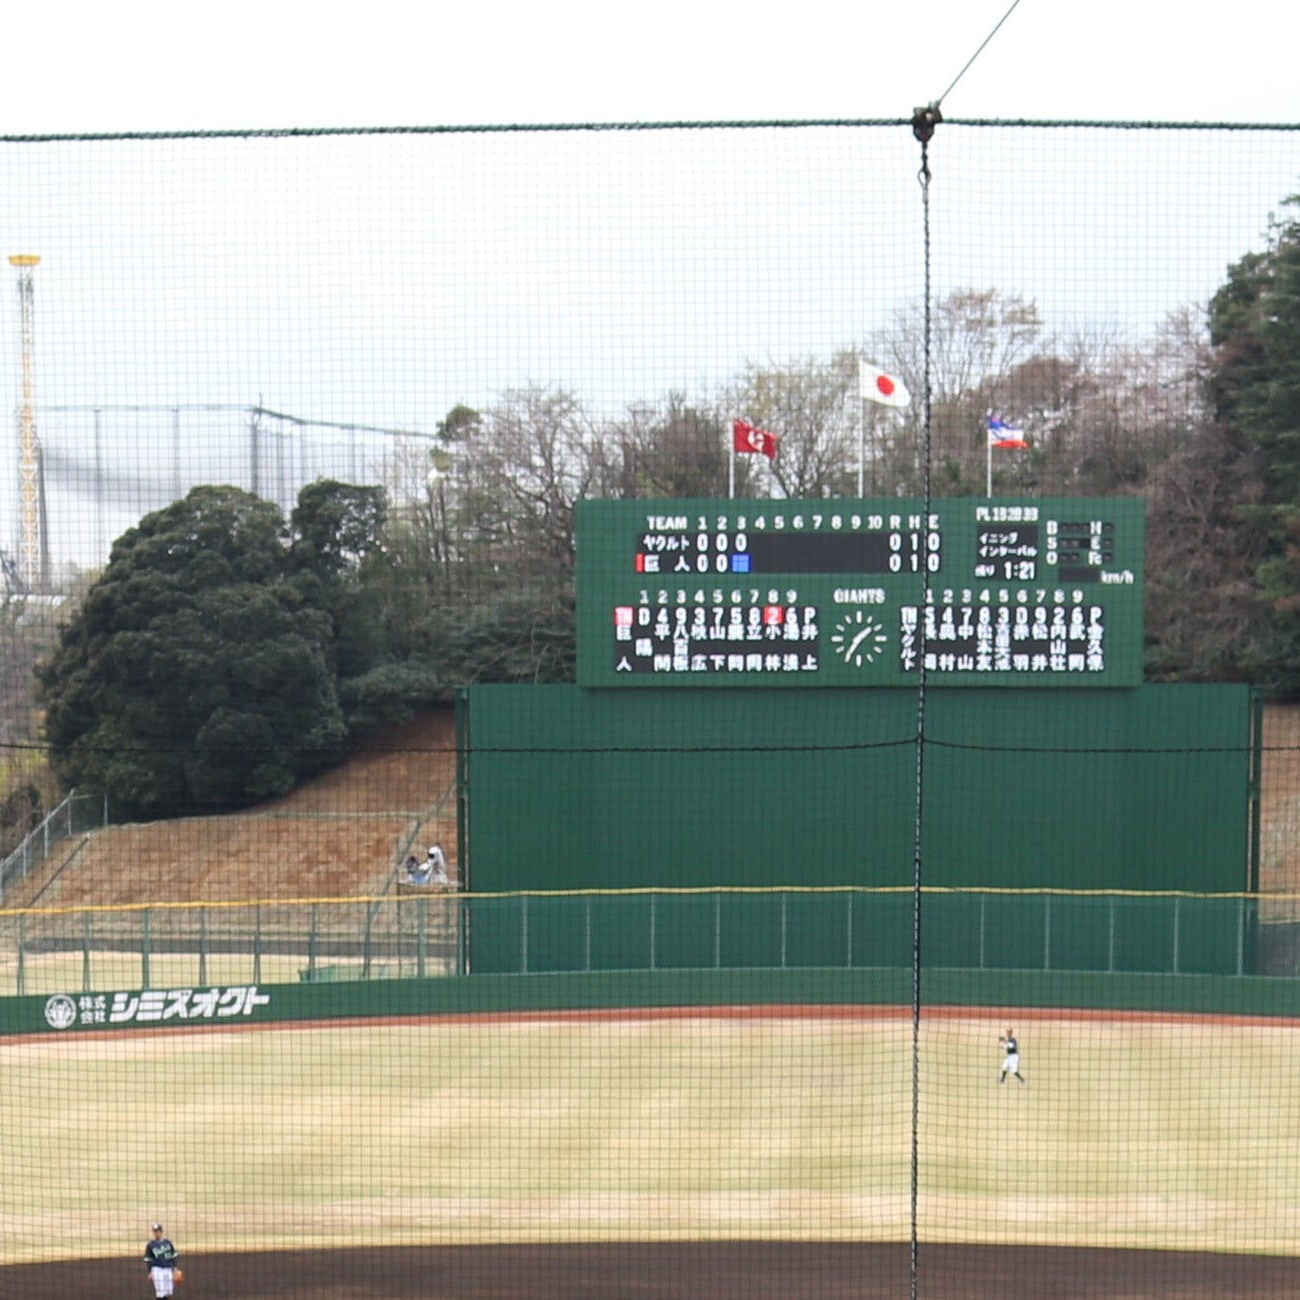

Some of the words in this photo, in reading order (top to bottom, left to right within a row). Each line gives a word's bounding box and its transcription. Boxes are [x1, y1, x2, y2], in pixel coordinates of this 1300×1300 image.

[646, 515, 688, 530] TEAM
[698, 515, 708, 530] 1
[717, 515, 728, 530] 2
[737, 515, 747, 530] 3
[754, 515, 765, 530] 4
[774, 515, 785, 530] 5
[793, 515, 804, 530] 6
[812, 515, 822, 530] 7
[831, 515, 842, 530] 8
[851, 515, 861, 530] 9
[868, 515, 883, 530] 10
[889, 515, 901, 530] R
[908, 515, 920, 530] H
[928, 515, 939, 530] E
[643, 534, 690, 551] ヤクルト
[697, 533, 708, 551] 0
[716, 533, 728, 551] 0
[735, 533, 747, 551] 0
[889, 533, 901, 551] 0
[910, 533, 918, 551] 1
[928, 533, 940, 551] 0
[697, 554, 708, 572] 0
[716, 554, 728, 572] 0
[889, 553, 901, 572] 0
[910, 553, 918, 572] 1
[928, 553, 940, 572] 0
[1004, 561, 1035, 580] 1:21
[1101, 569, 1134, 585] km/h
[639, 590, 649, 604] 1
[658, 590, 668, 604] 2
[676, 590, 686, 604] 3
[694, 590, 704, 604] 4
[712, 590, 723, 604] 5
[731, 590, 742, 604] 6
[750, 590, 759, 604] 7
[768, 590, 778, 604] 8
[786, 590, 797, 604] 9
[833, 588, 885, 604] GIANTS
[926, 589, 933, 604] 1
[943, 589, 953, 604] 2
[962, 589, 972, 604] 3
[979, 589, 990, 604] 4
[999, 589, 1009, 604] 5
[1016, 589, 1028, 604] 6
[1036, 589, 1045, 604] 7
[1053, 589, 1064, 604] 8
[1072, 589, 1083, 604] 9
[638, 607, 650, 624] D
[657, 607, 668, 624] 4
[675, 607, 687, 624] 9
[694, 607, 705, 624] 3
[712, 607, 723, 624] 7
[730, 607, 742, 624] 5
[749, 607, 760, 624] 8
[767, 607, 779, 624] 2
[786, 607, 797, 624] 6
[804, 607, 816, 624] P
[925, 607, 935, 624] 5
[942, 607, 953, 624] 4
[961, 607, 973, 624] 7
[979, 607, 990, 624] 8
[998, 607, 1009, 624] 3
[1016, 607, 1028, 624] D
[1035, 607, 1046, 624] 9
[1053, 607, 1065, 624] 2
[1071, 607, 1083, 624] 6
[1090, 607, 1101, 624] P
[710, 624, 725, 672] 山下
[765, 624, 781, 672] 小林
[802, 624, 818, 672] 井上
[901, 624, 917, 671] ヤクルト
[958, 624, 974, 671] 中山
[1032, 624, 1048, 671] 松井
[78, 995, 106, 1010] 株式
[109, 986, 270, 1023] シミズオクト
[79, 1010, 106, 1025] 会社
